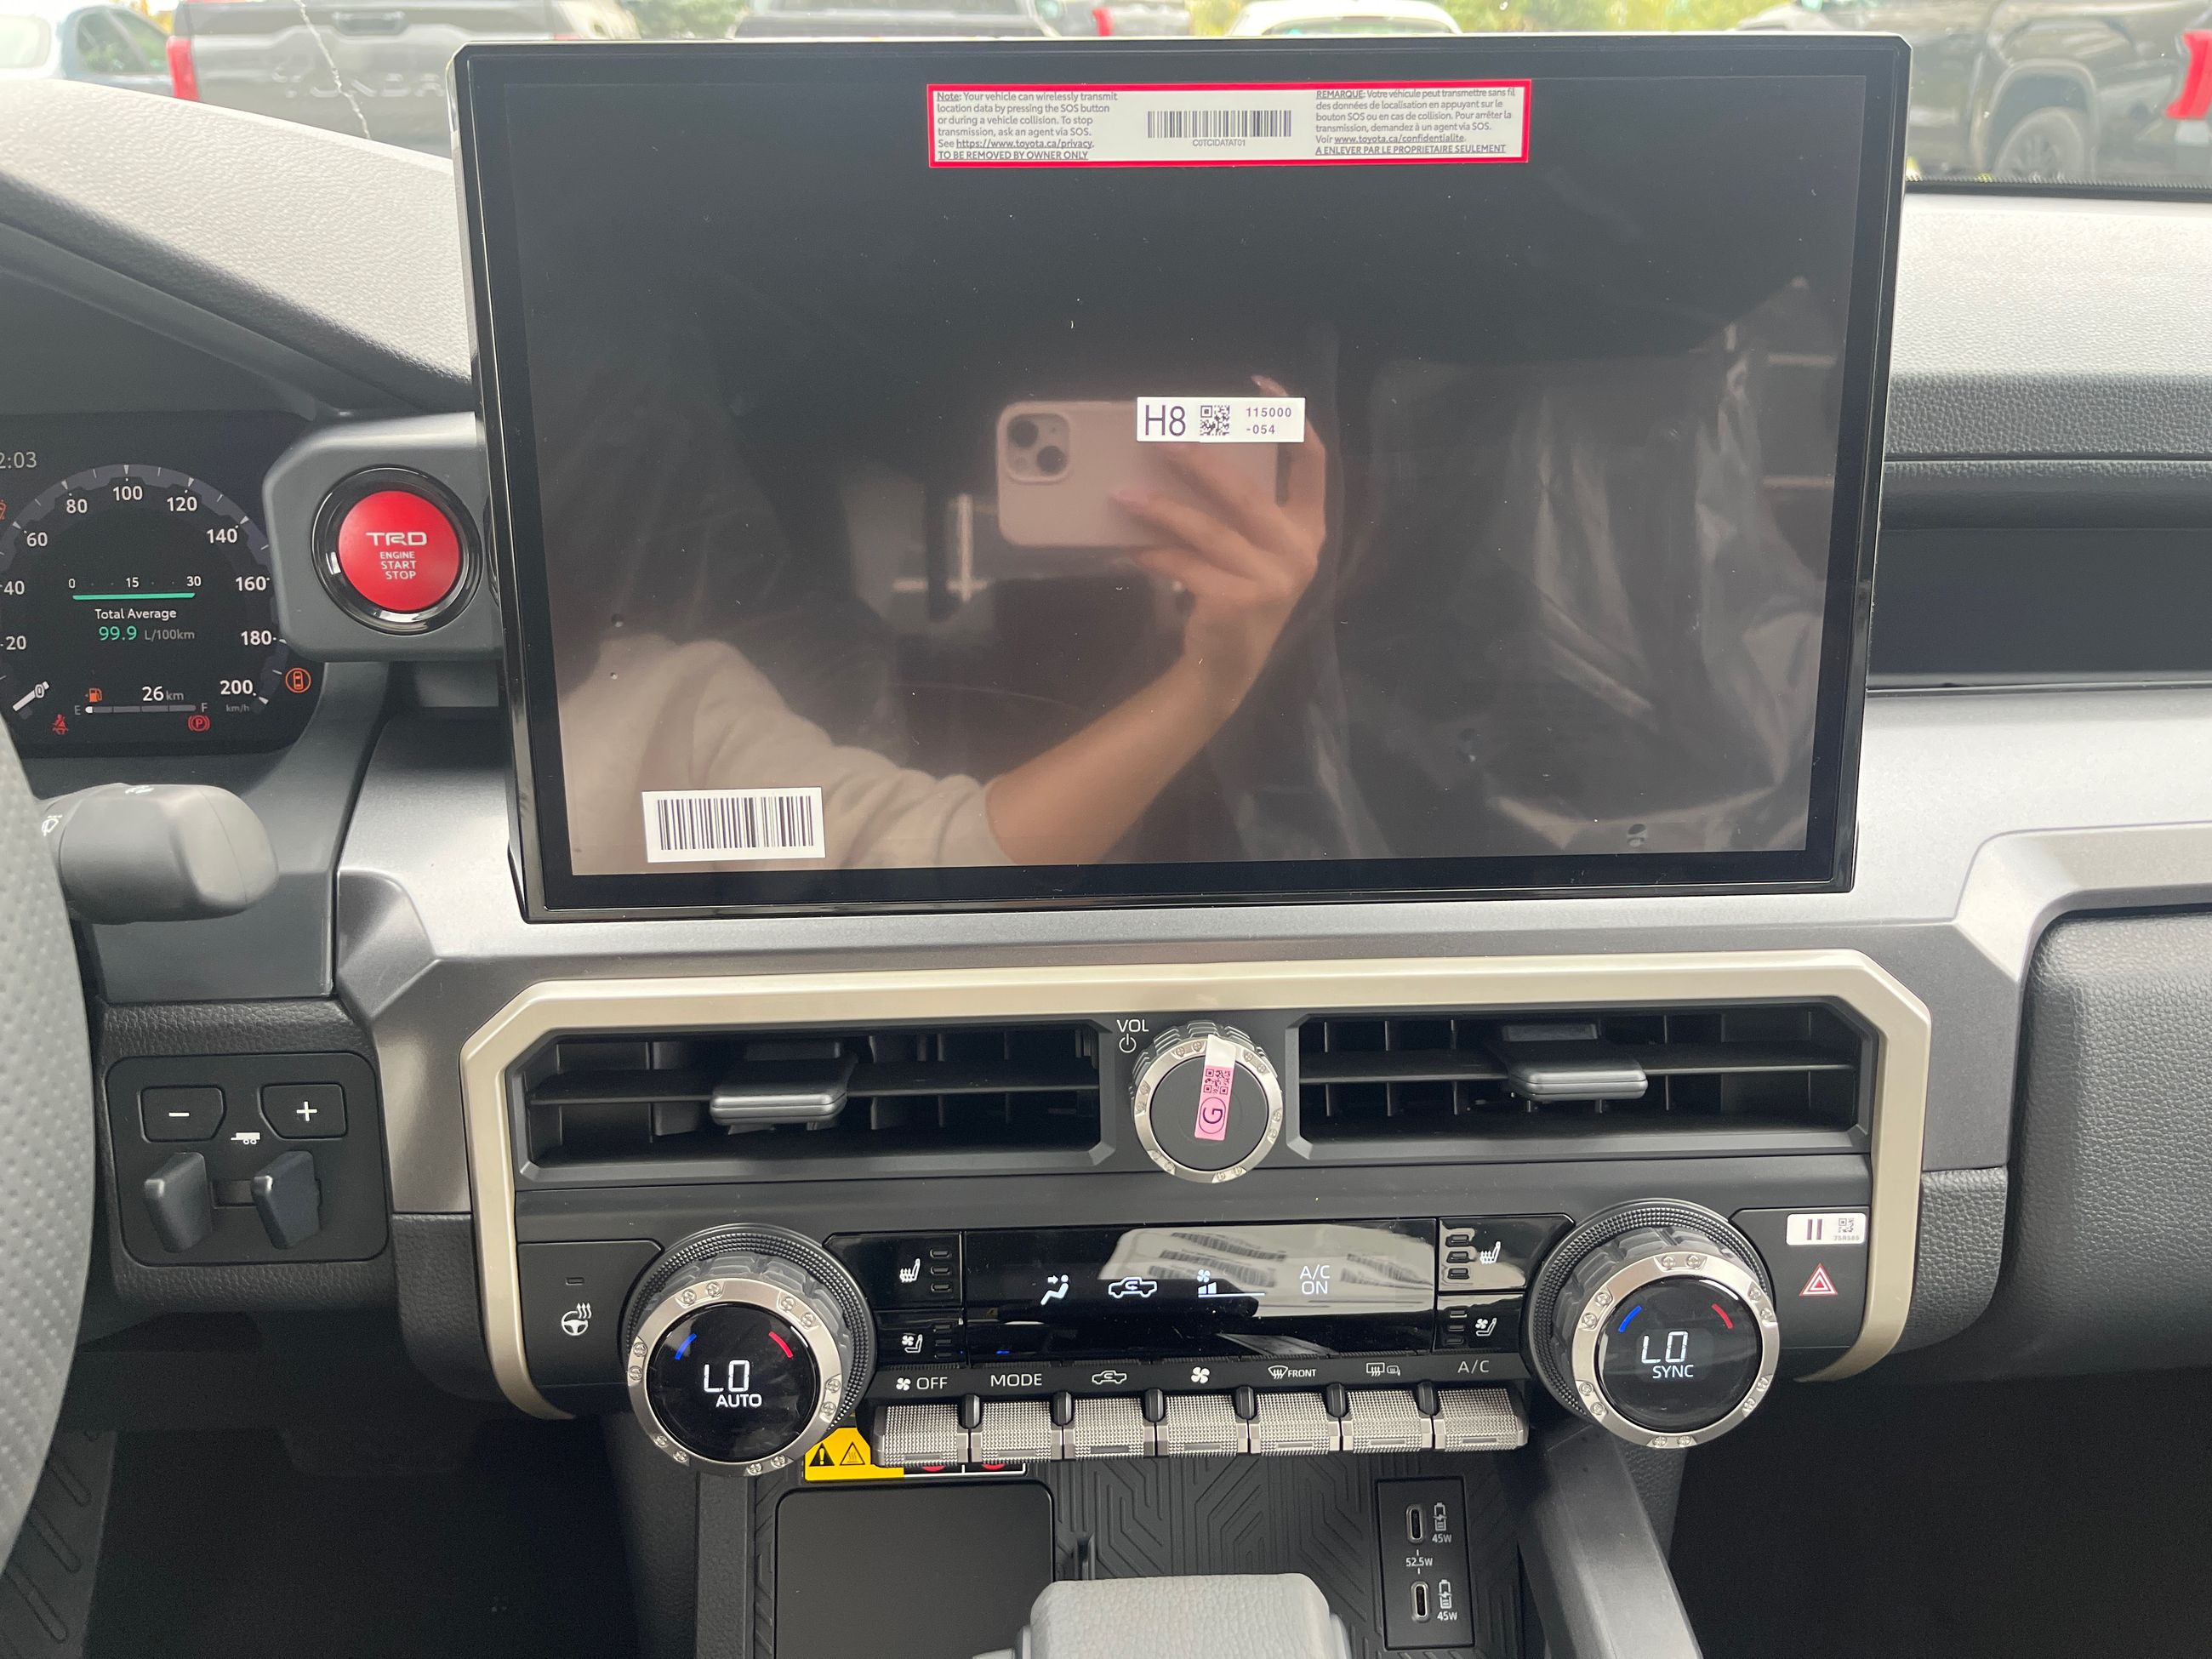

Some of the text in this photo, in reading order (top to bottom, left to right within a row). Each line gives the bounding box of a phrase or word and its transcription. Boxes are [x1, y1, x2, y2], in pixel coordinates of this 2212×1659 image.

[937, 92, 962, 101] Note:
[963, 92, 984, 100] Your
[985, 92, 1017, 100] vehicle
[1035, 92, 1079, 102] wirelessly
[1080, 92, 1118, 100] transmit
[1316, 90, 1365, 100] REMARQUE:
[1366, 89, 1388, 98] Votre
[1389, 88, 1421, 98] véhicule
[1422, 90, 1440, 99] peut
[1442, 88, 1487, 97] transmettre
[1507, 87, 1516, 96] fil
[938, 104, 1109, 114] location data by pressing the SOS button
[1316, 101, 1331, 110] des
[1332, 100, 1368, 110] données
[1369, 100, 1380, 109] de
[1382, 100, 1428, 109] localisation
[1440, 100, 1479, 110] appuyant
[949, 116, 978, 126] during
[987, 116, 1018, 124] vehicle
[1020, 116, 1059, 124] collision.
[1061, 116, 1071, 124] To
[1073, 117, 1093, 126] stop
[1316, 112, 1346, 121] bouton
[1348, 112, 1365, 121] SOS
[1405, 111, 1417, 120] de
[1418, 111, 1453, 120] collision.
[1475, 110, 1502, 119] arrêter
[1504, 110, 1512, 118] la
[938, 128, 996, 137] transmission,
[998, 128, 1013, 136] ask
[1028, 128, 1054, 138] agent
[1056, 128, 1068, 136] via
[1070, 128, 1092, 136] SOS.
[1316, 123, 1369, 133] transmission,
[1371, 123, 1413, 132] demandez
[1415, 123, 1420, 131] à
[1434, 123, 1457, 133] agent
[1472, 122, 1491, 130] SOS.
[938, 139, 1095, 149] See https://www.toyota.ca/privacy.
[1315, 134, 1467, 144] Voir www.toyota.ca/confidentialite.
[938, 151, 1089, 160] TO BE REMOVED BY OWNER ONLY
[1315, 144, 1507, 156] A ENLEVER PAR LE PROPRIETAIRE SEULEMENT
[1246, 408, 1291, 418] 115000
[1145, 404, 1186, 436] H8
[1246, 425, 1275, 434] -054
[113, 486, 143, 501] 100
[66, 499, 88, 513] 80
[167, 496, 197, 511] 120
[26, 532, 48, 546] 60
[207, 528, 237, 544] 140
[366, 532, 428, 546] TRD
[380, 551, 415, 560] ENGINE
[380, 561, 416, 570] START
[385, 571, 416, 579] STOP
[68, 578, 76, 589] 0
[126, 578, 140, 588] 15
[186, 576, 202, 587] 30
[236, 576, 266, 591] 160
[4, 581, 25, 596] 40
[95, 608, 177, 621] Total Average
[99, 626, 195, 641] 99.9 L/100km
[241, 630, 272, 646] 180
[6, 636, 26, 650] 20
[142, 686, 184, 701] 26 km
[220, 680, 254, 695] 200
[74, 705, 81, 715] E
[201, 703, 208, 712] F
[225, 703, 250, 713] km/h
[1116, 1018, 1149, 1033] VOL
[1202, 1107, 1223, 1124] G
[1299, 1264, 1331, 1280] A/C
[1301, 1281, 1328, 1295] ON
[1287, 1368, 1316, 1377] FRONT
[1457, 1360, 1490, 1373] A/C
[1652, 1365, 1694, 1379] SYNC
[916, 1377, 948, 1390] OFF
[990, 1373, 1042, 1387] MODE
[715, 1394, 762, 1408] AUTO
[1432, 1534, 1452, 1543] 45W
[1405, 1557, 1433, 1567] 52.5W
[1437, 1611, 1457, 1621] 45W
